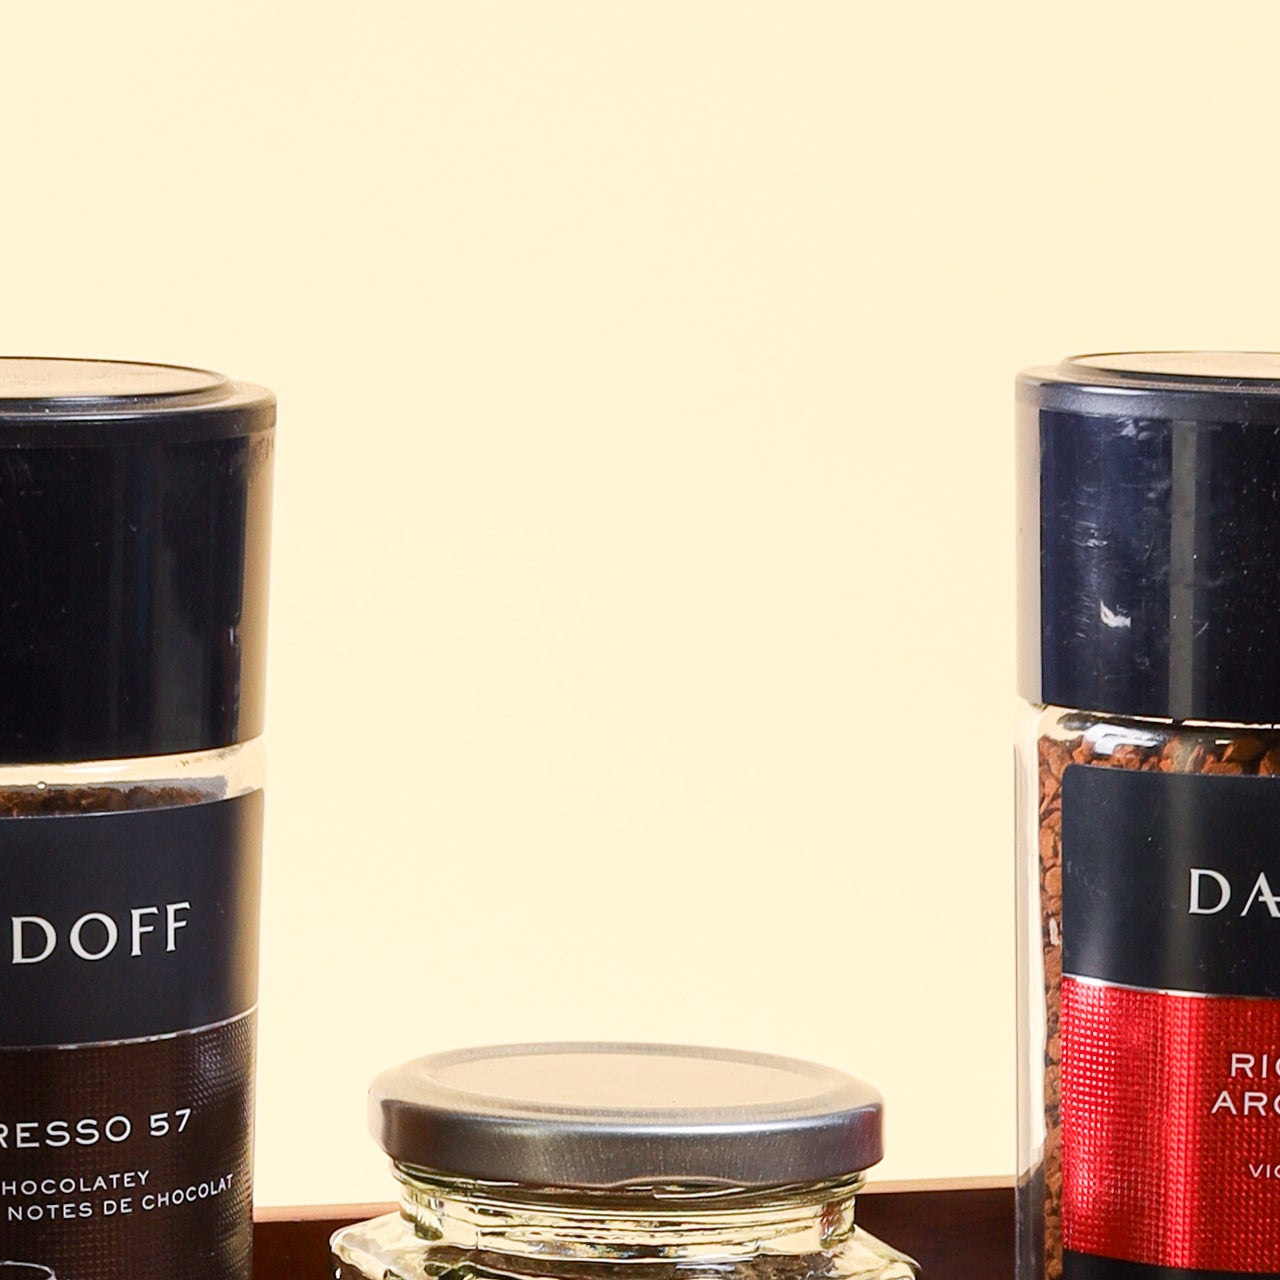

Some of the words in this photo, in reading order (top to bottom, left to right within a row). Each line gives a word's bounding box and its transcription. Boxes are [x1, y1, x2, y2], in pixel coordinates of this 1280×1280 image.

[149, 1108, 191, 1137] 57
[8, 1202, 93, 1222] NOTES
[103, 1198, 133, 1216] DE
[141, 1173, 234, 1211] CHOCOLAT
